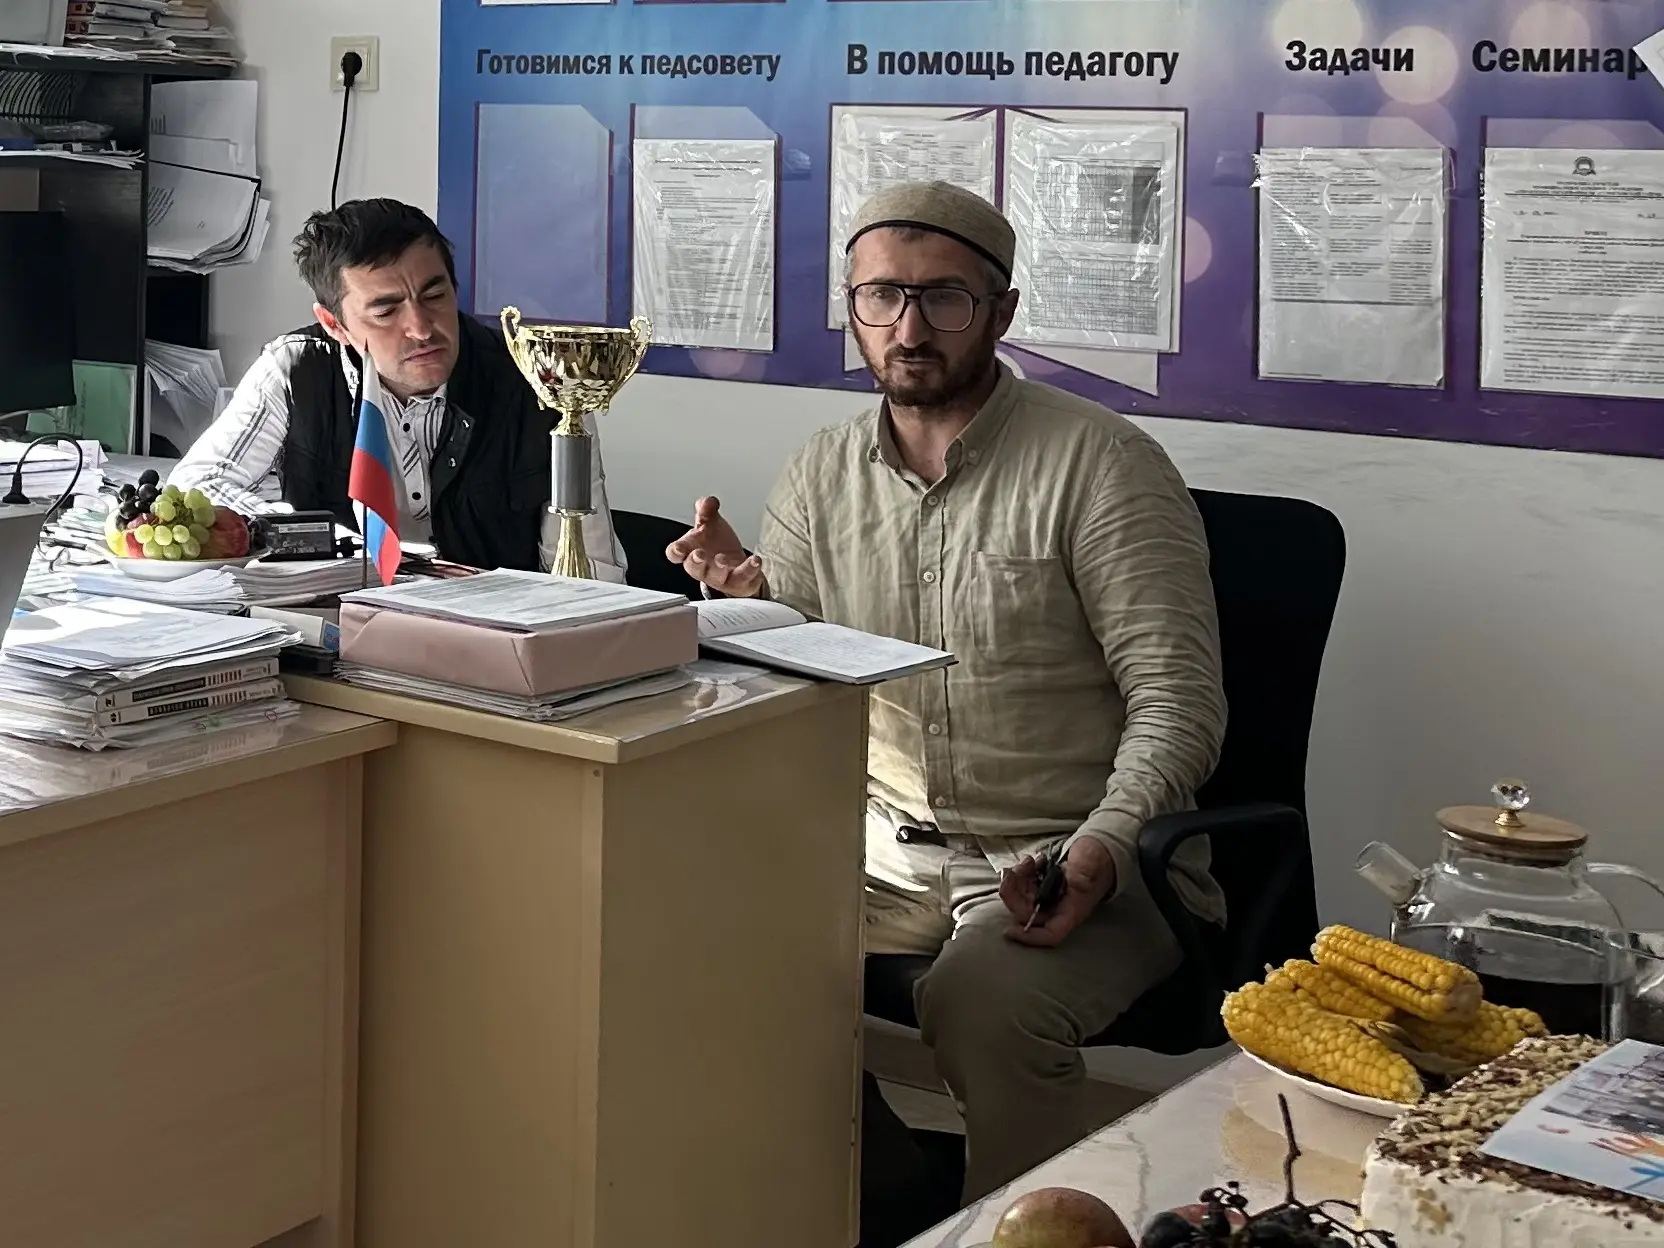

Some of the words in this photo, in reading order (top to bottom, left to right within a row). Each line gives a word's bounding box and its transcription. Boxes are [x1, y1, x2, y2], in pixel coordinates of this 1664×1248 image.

[476, 49, 611, 75] Готовимся
[618, 54, 635, 75] к
[641, 54, 781, 81] педсовету
[847, 43, 868, 75] В
[878, 51, 1015, 81] помощь
[1024, 51, 1180, 84] педагогу
[1284, 40, 1414, 75] Задачи
